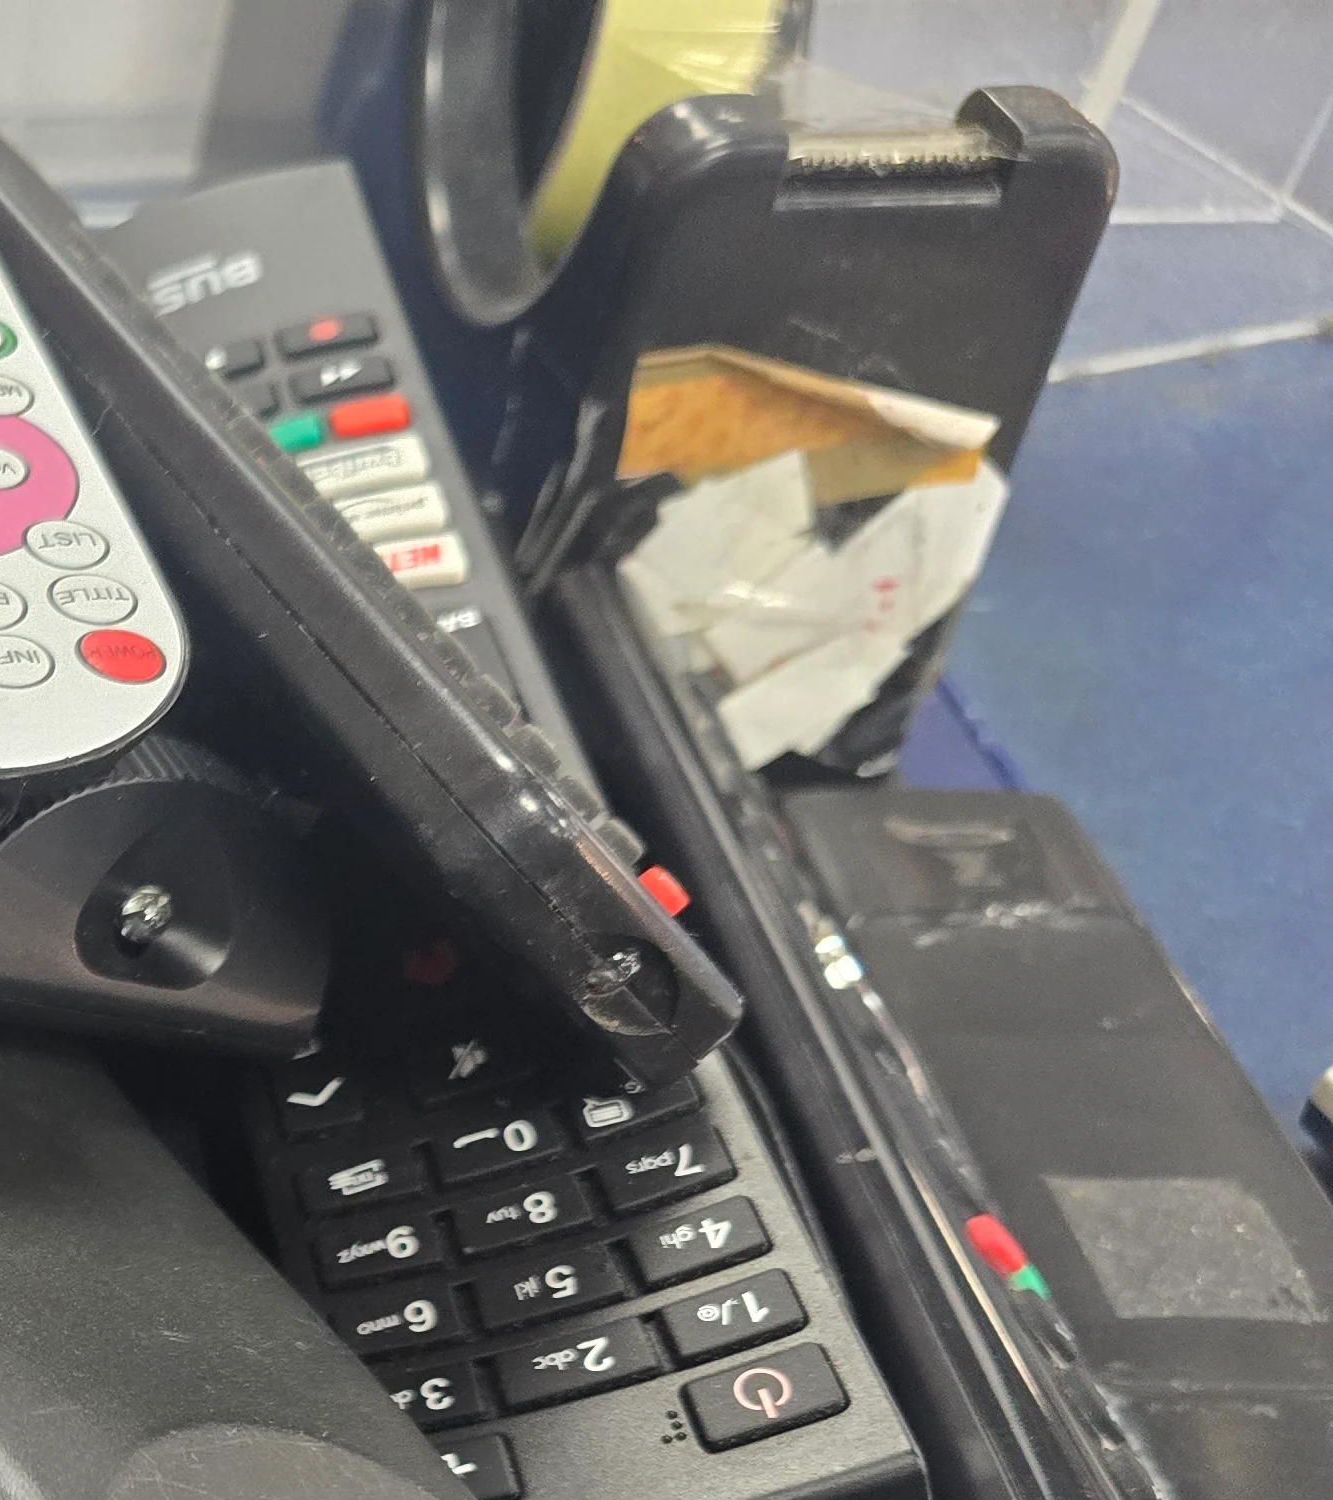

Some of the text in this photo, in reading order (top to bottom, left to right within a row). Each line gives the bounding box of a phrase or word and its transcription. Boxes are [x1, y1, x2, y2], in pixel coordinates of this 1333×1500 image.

[147, 250, 263, 316] BUS
[38, 531, 97, 549] LIST
[56, 590, 130, 606] TITLE
[504, 1120, 537, 1152] 0
[420, 1377, 455, 1411] 3
